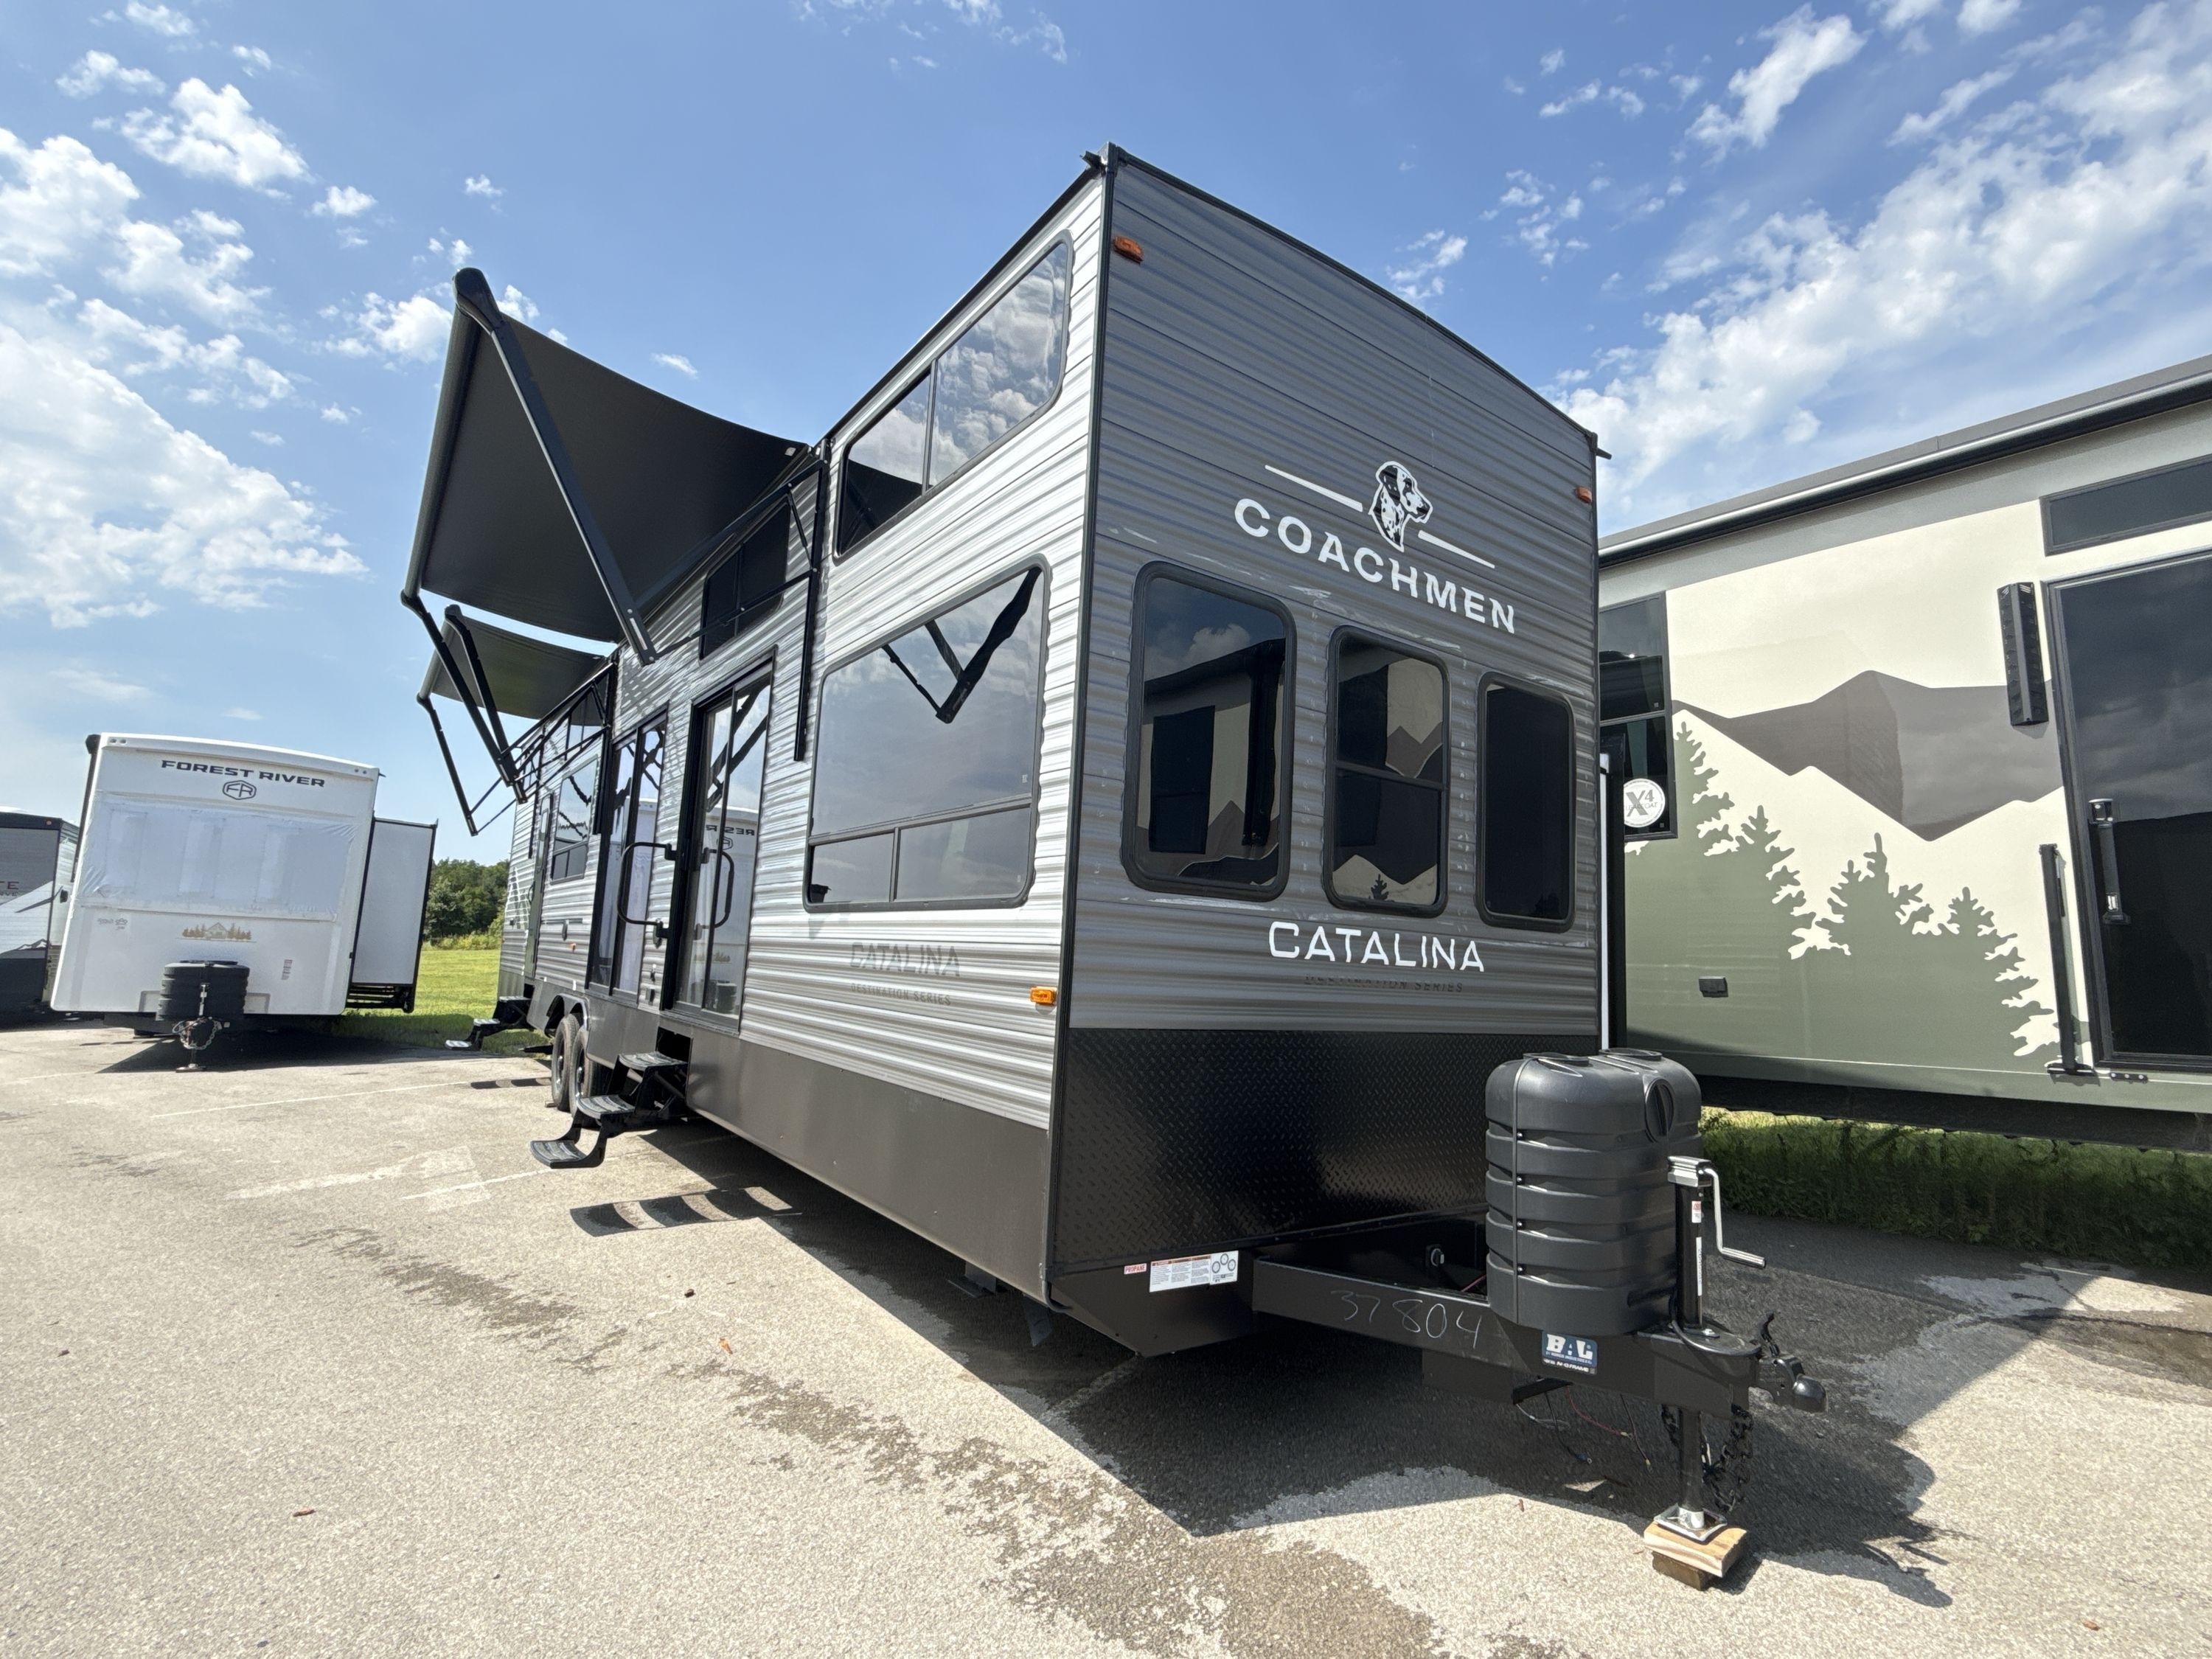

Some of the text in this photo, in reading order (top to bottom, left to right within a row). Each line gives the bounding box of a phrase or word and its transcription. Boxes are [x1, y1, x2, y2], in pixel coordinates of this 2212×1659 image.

[1234, 498, 1514, 634] COACHMEN
[161, 760, 325, 787] FOREST RIVER
[850, 942, 960, 977] CATALINA
[1268, 921, 1485, 972] CATALINA
[851, 983, 951, 1006] DESTINATION SERIES
[1414, 981, 1464, 992] SERIES
[1125, 1264, 1146, 1273] PROPANE
[1546, 1333, 1593, 1360] BAL
